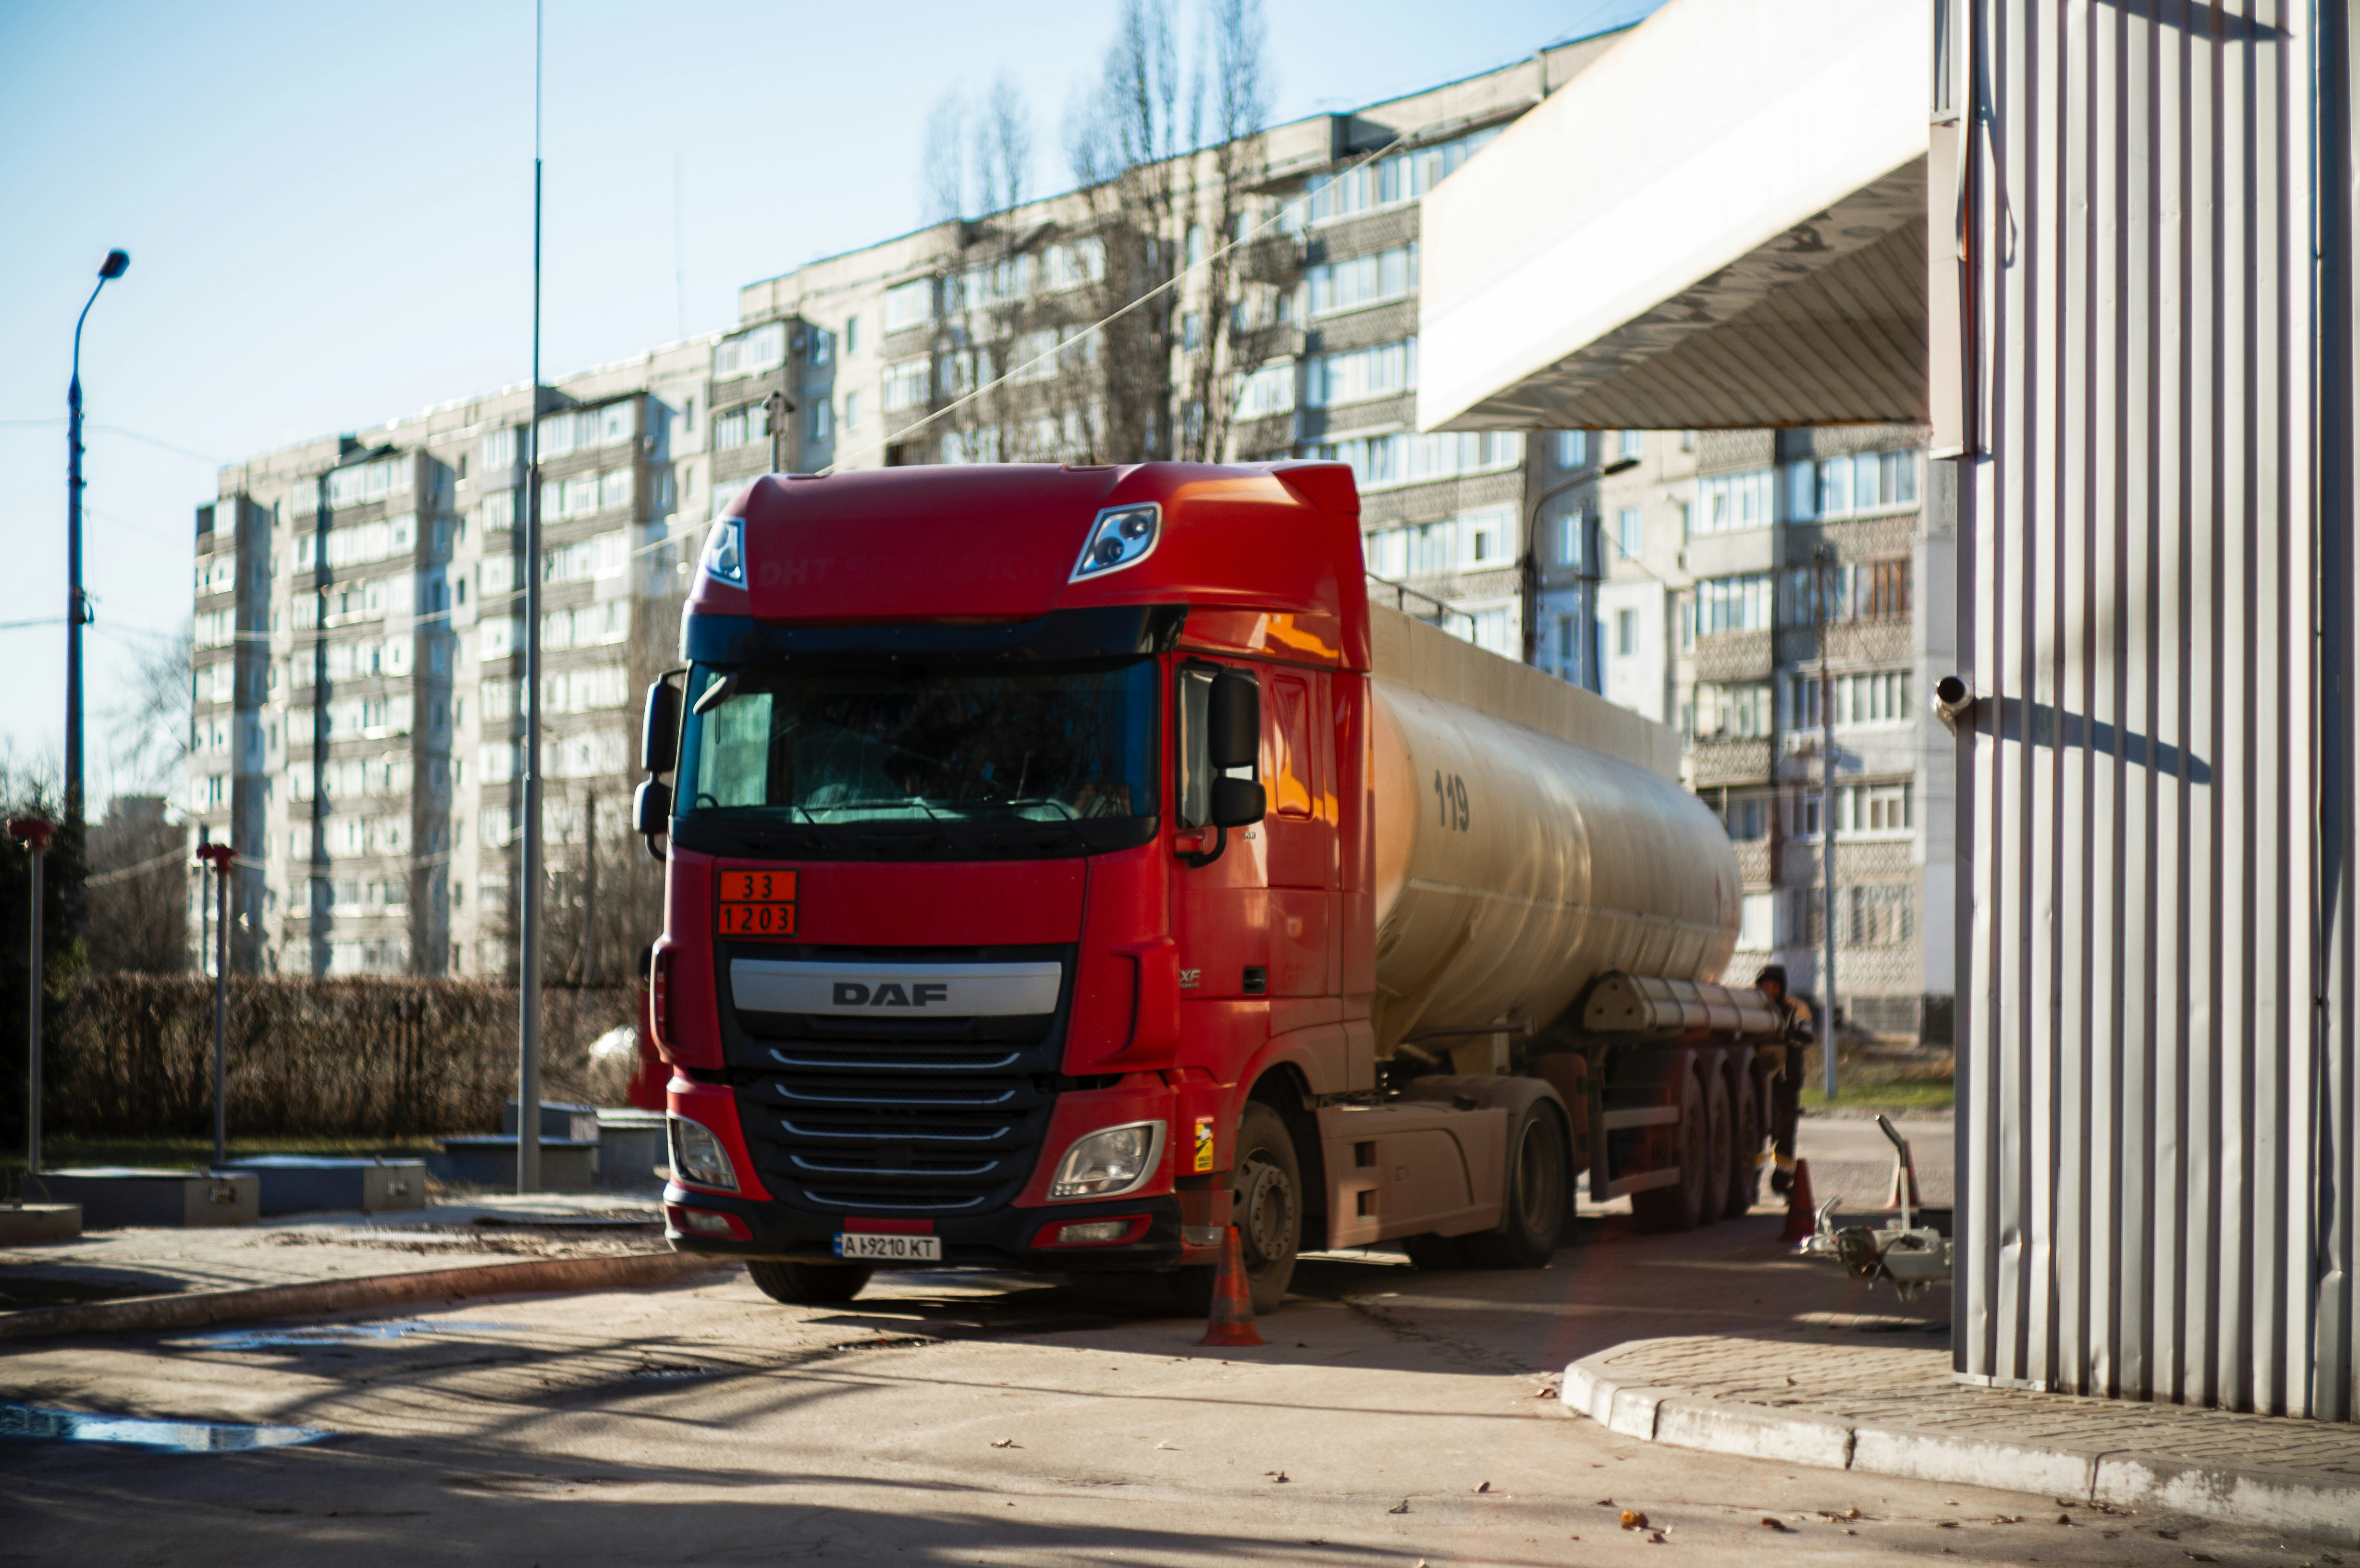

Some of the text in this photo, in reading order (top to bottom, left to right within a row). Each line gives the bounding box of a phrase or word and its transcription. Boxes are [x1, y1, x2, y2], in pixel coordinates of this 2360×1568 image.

[1435, 770, 1470, 833] 119
[743, 875, 772, 898] 33
[724, 906, 788, 931] 1203
[1180, 969, 1201, 982] XF
[833, 982, 947, 1006] DAF
[910, 1239, 934, 1257] KT
